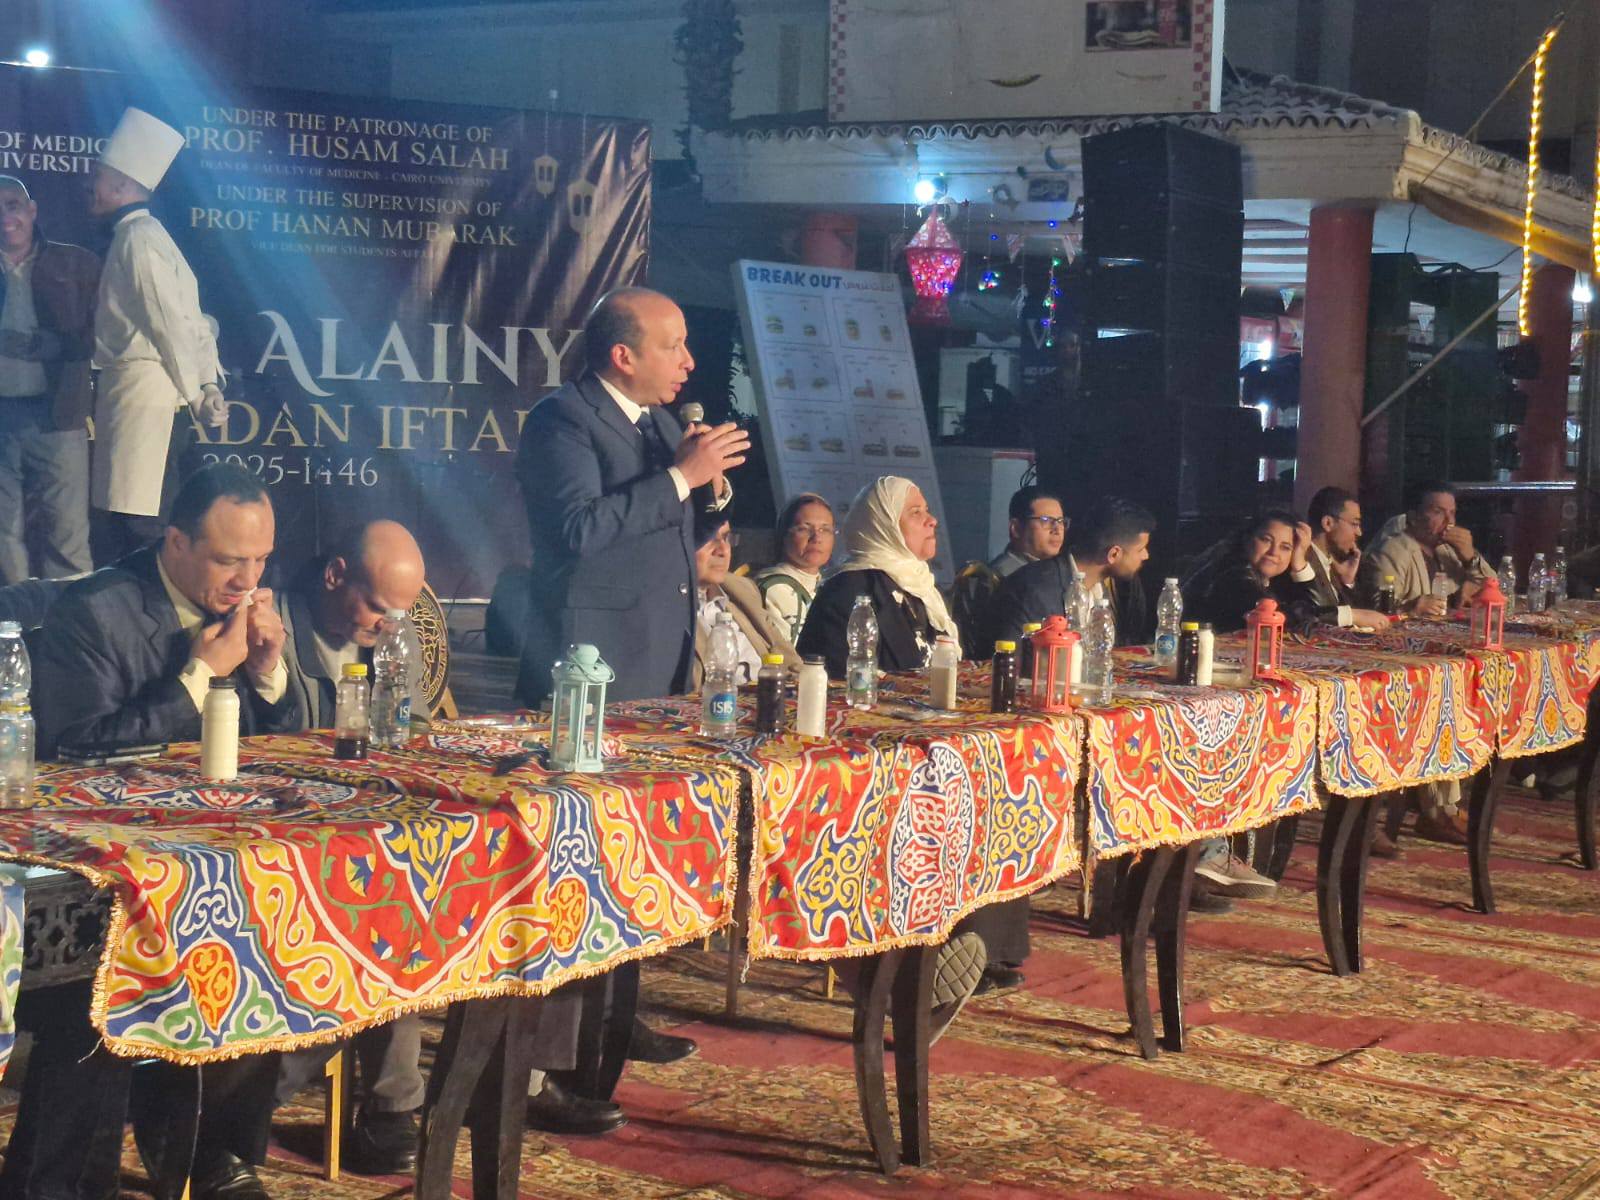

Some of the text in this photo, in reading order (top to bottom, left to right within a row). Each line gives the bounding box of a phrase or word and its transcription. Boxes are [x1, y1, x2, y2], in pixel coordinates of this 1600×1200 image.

[202, 106, 493, 144] UNDER THE PATRONAGE OF
[33, 134, 113, 154] MEDIC
[289, 134, 400, 163] HUSAM
[410, 142, 512, 171] SALAH
[0, 151, 102, 174] IVERSIT
[216, 184, 503, 217] UNDER THE SUPERVISION OF
[191, 207, 517, 246] PROF HANAN MUBARAK
[746, 266, 806, 287] BREAK
[809, 275, 843, 289] OUT
[255, 310, 585, 398] ALAINY
[376, 404, 529, 453] IFTA
[713, 700, 734, 714] ISIS
